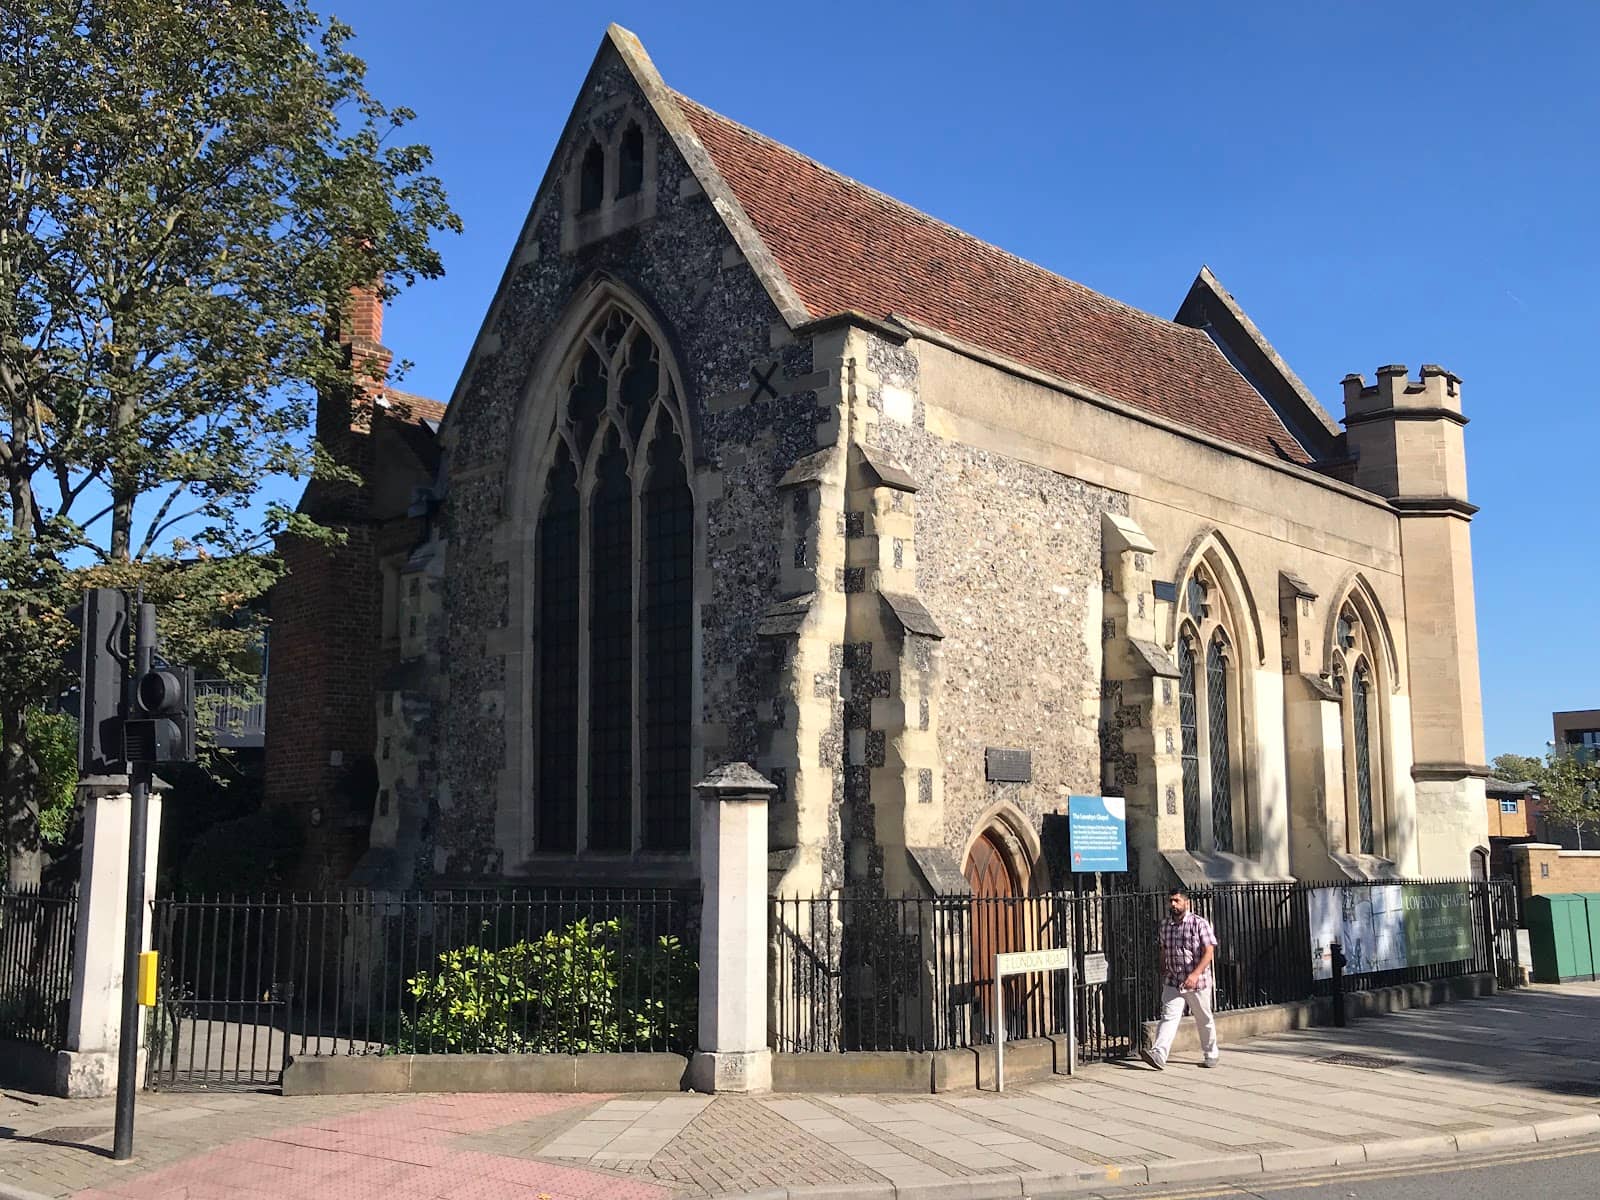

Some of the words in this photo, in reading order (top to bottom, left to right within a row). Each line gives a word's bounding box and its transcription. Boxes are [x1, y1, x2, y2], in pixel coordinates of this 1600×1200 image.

[1405, 895, 1440, 910] LOVEKYN
[1441, 893, 1468, 909] CHAPEL
[1011, 954, 1043, 969] LONDON
[1046, 952, 1066, 966] ROAD
